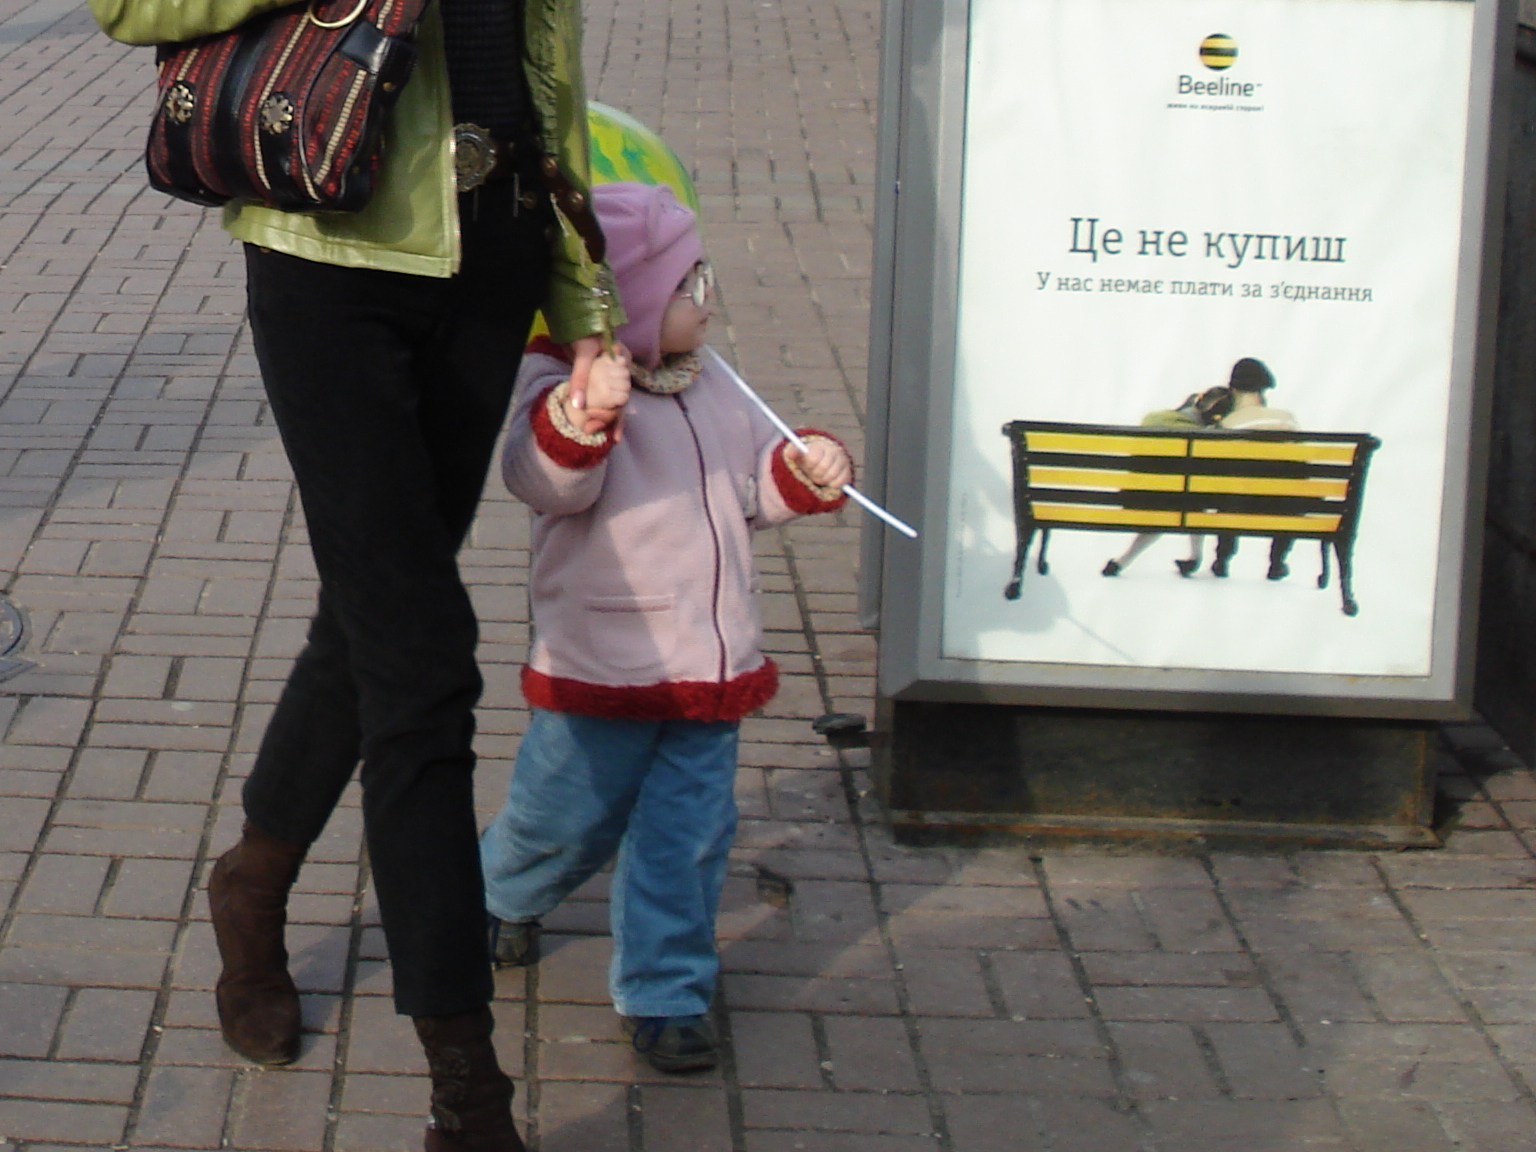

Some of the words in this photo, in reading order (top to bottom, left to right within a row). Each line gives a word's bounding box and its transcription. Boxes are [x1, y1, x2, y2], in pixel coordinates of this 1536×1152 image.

[1178, 75, 1254, 97] Beeline
[1068, 217, 1123, 263] Це
[1137, 230, 1189, 257] не
[1203, 232, 1348, 269] купиш
[1036, 271, 1051, 290] У
[1056, 277, 1093, 292] нас
[1099, 278, 1164, 294] немає
[1170, 280, 1234, 296] плати
[1241, 283, 1263, 298] за
[1270, 281, 1374, 302] з'єднання
